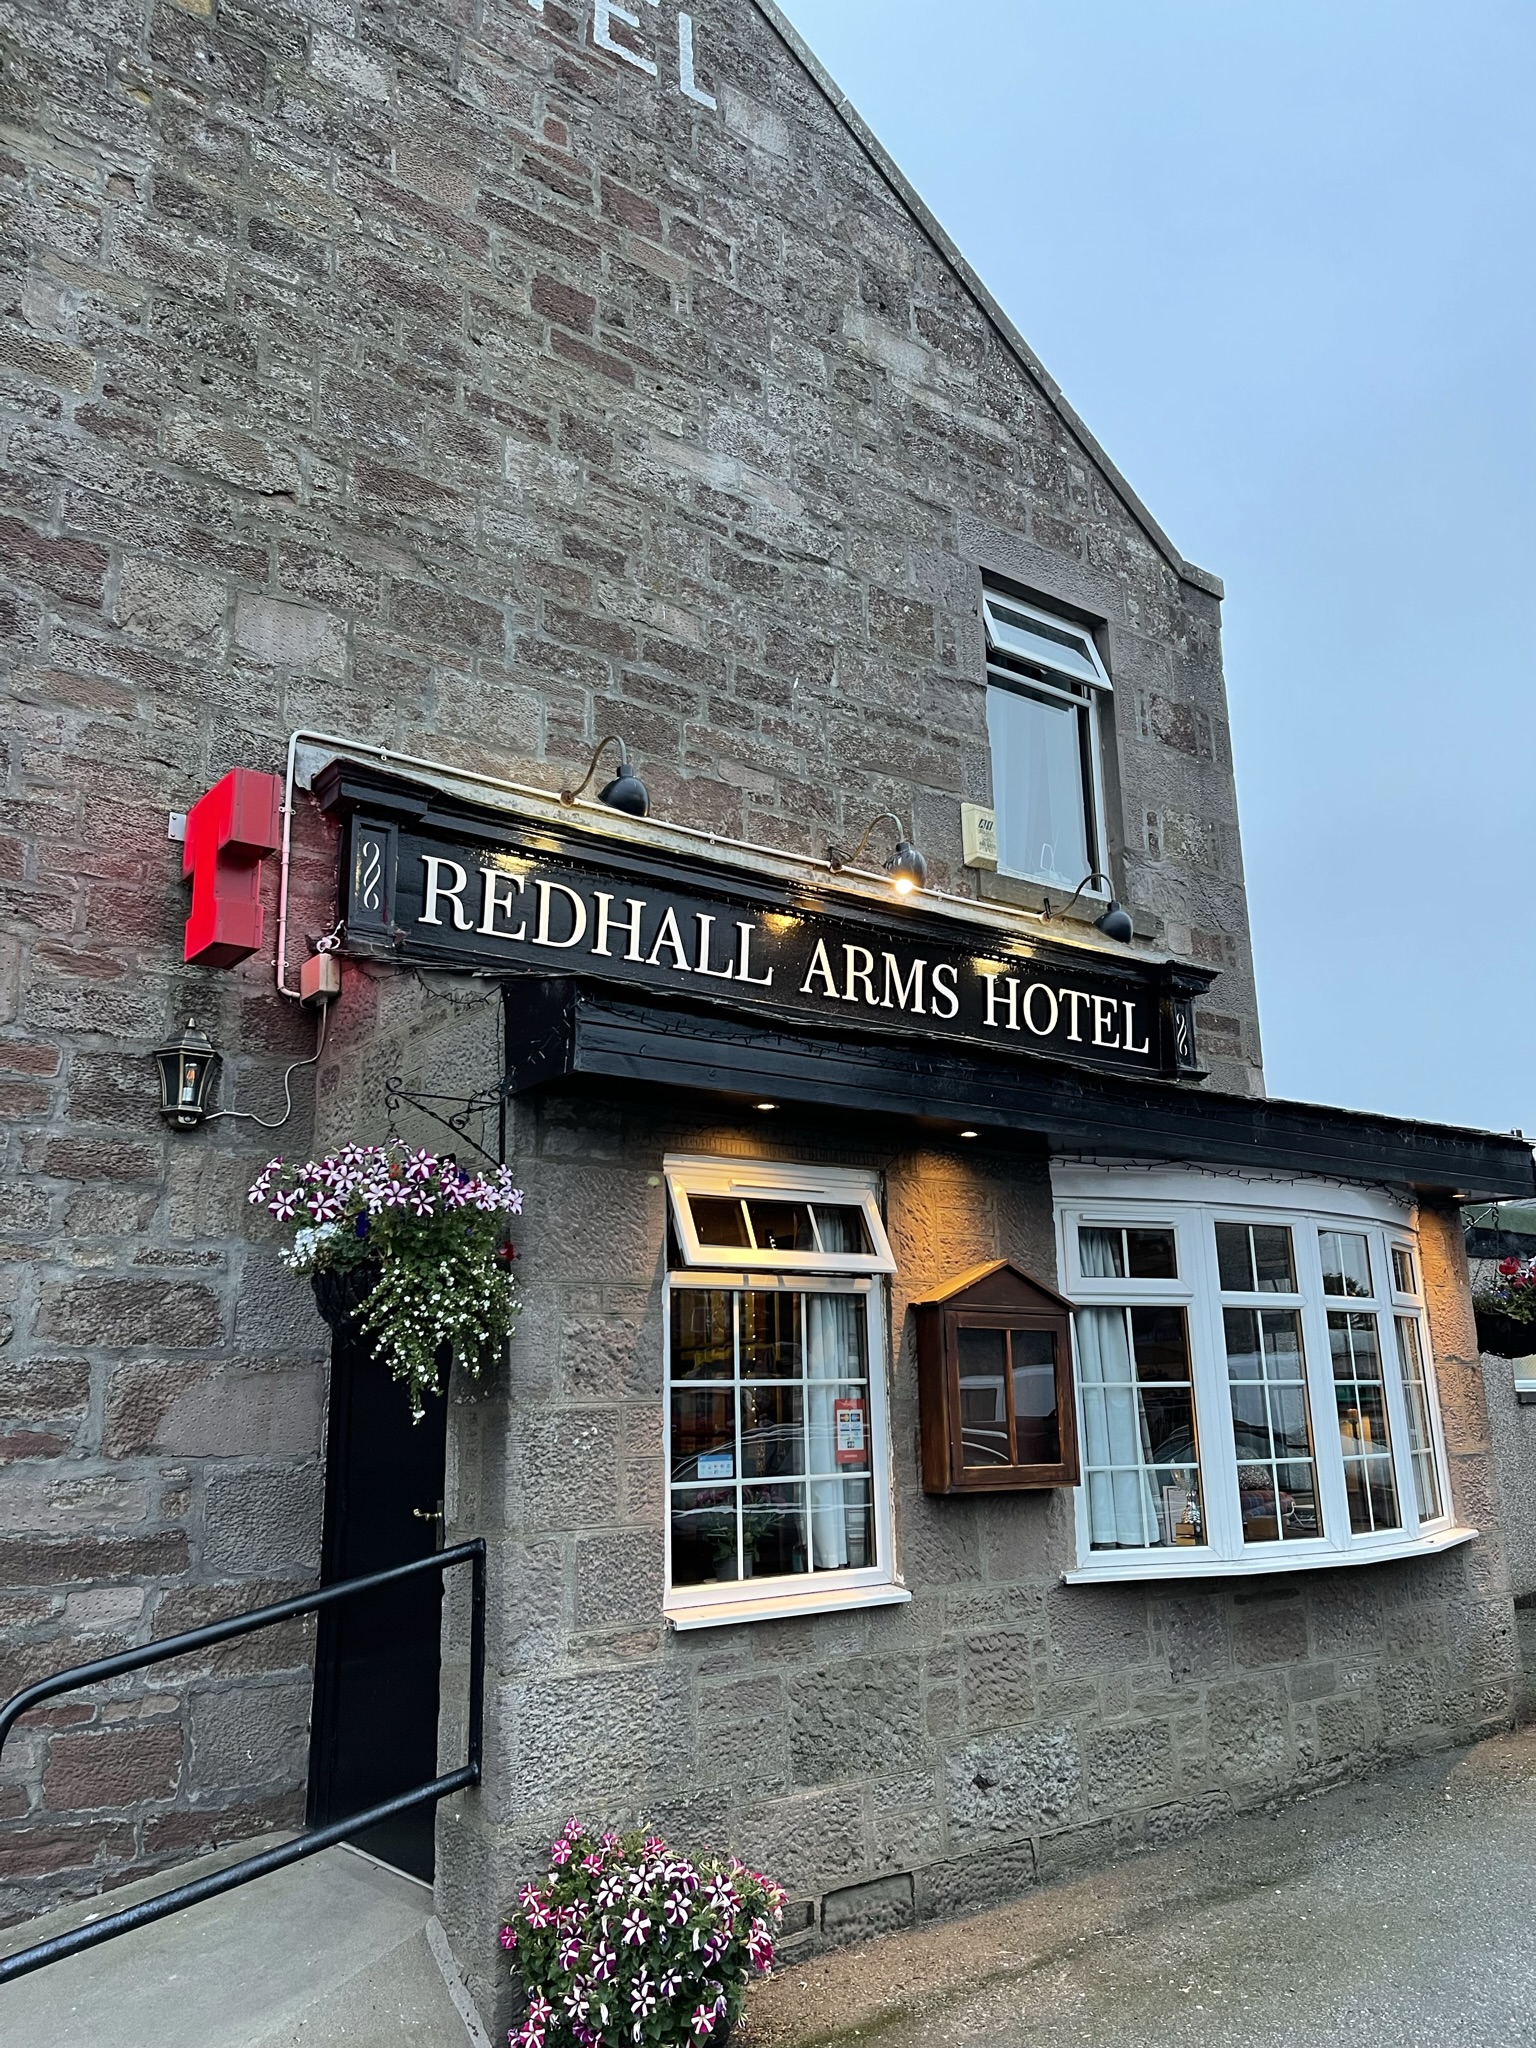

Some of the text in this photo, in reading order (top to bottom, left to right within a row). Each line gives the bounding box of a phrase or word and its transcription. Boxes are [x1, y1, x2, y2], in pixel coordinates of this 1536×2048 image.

[418, 855, 1150, 1054] REDHALL ARMS HOTEL
